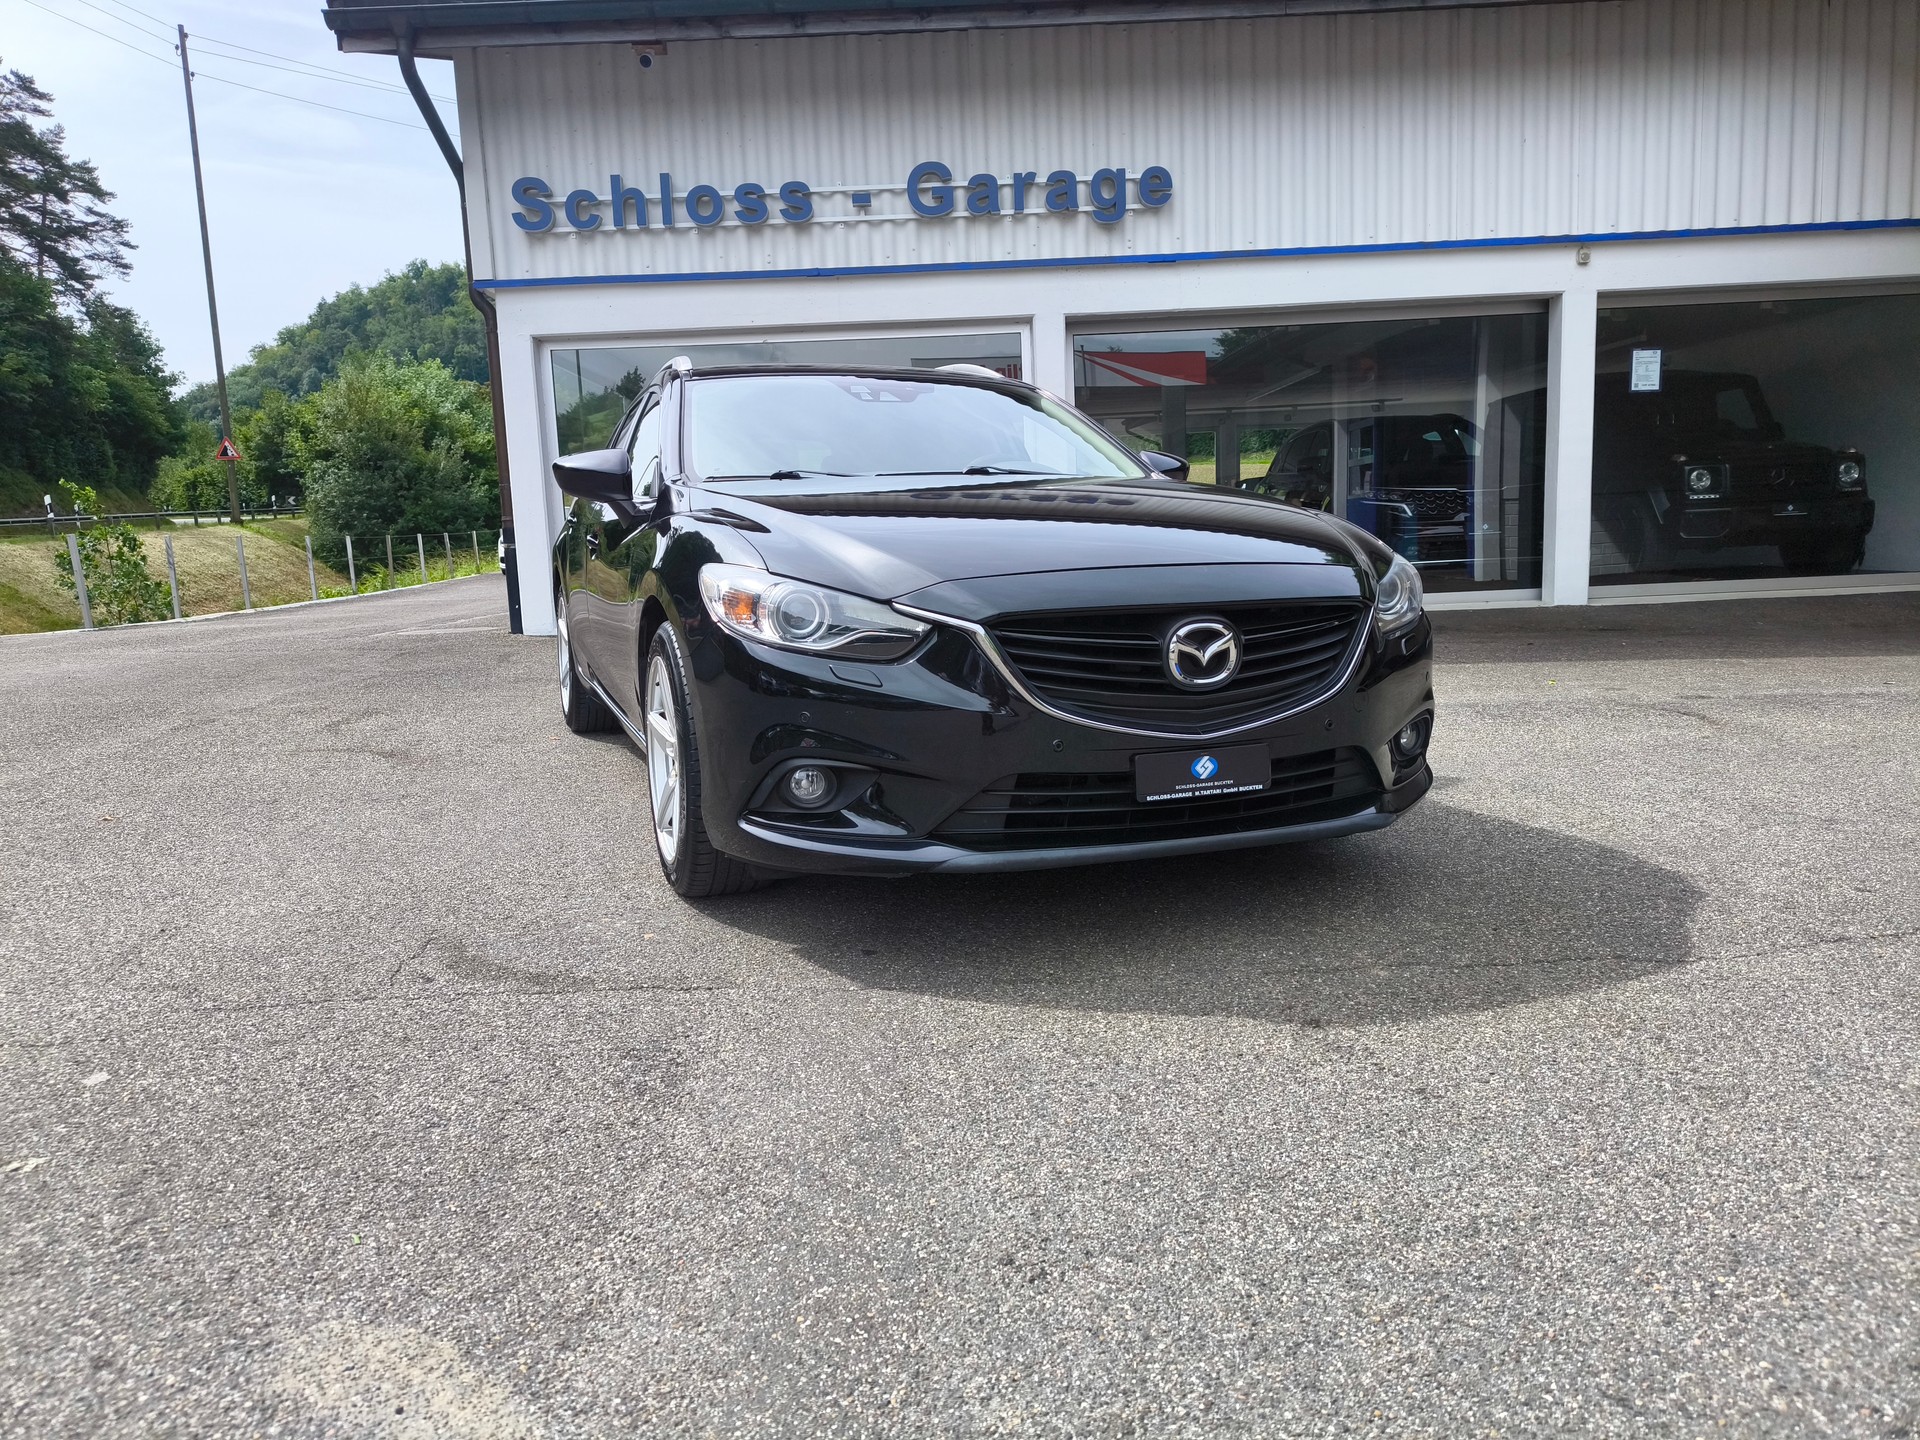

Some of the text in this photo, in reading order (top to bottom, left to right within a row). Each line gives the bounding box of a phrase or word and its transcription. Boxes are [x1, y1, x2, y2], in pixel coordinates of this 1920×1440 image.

[511, 172, 815, 233] Schloss
[906, 160, 1173, 224] Garage
[1146, 792, 1192, 801] SCHLOSS-GARAGE
